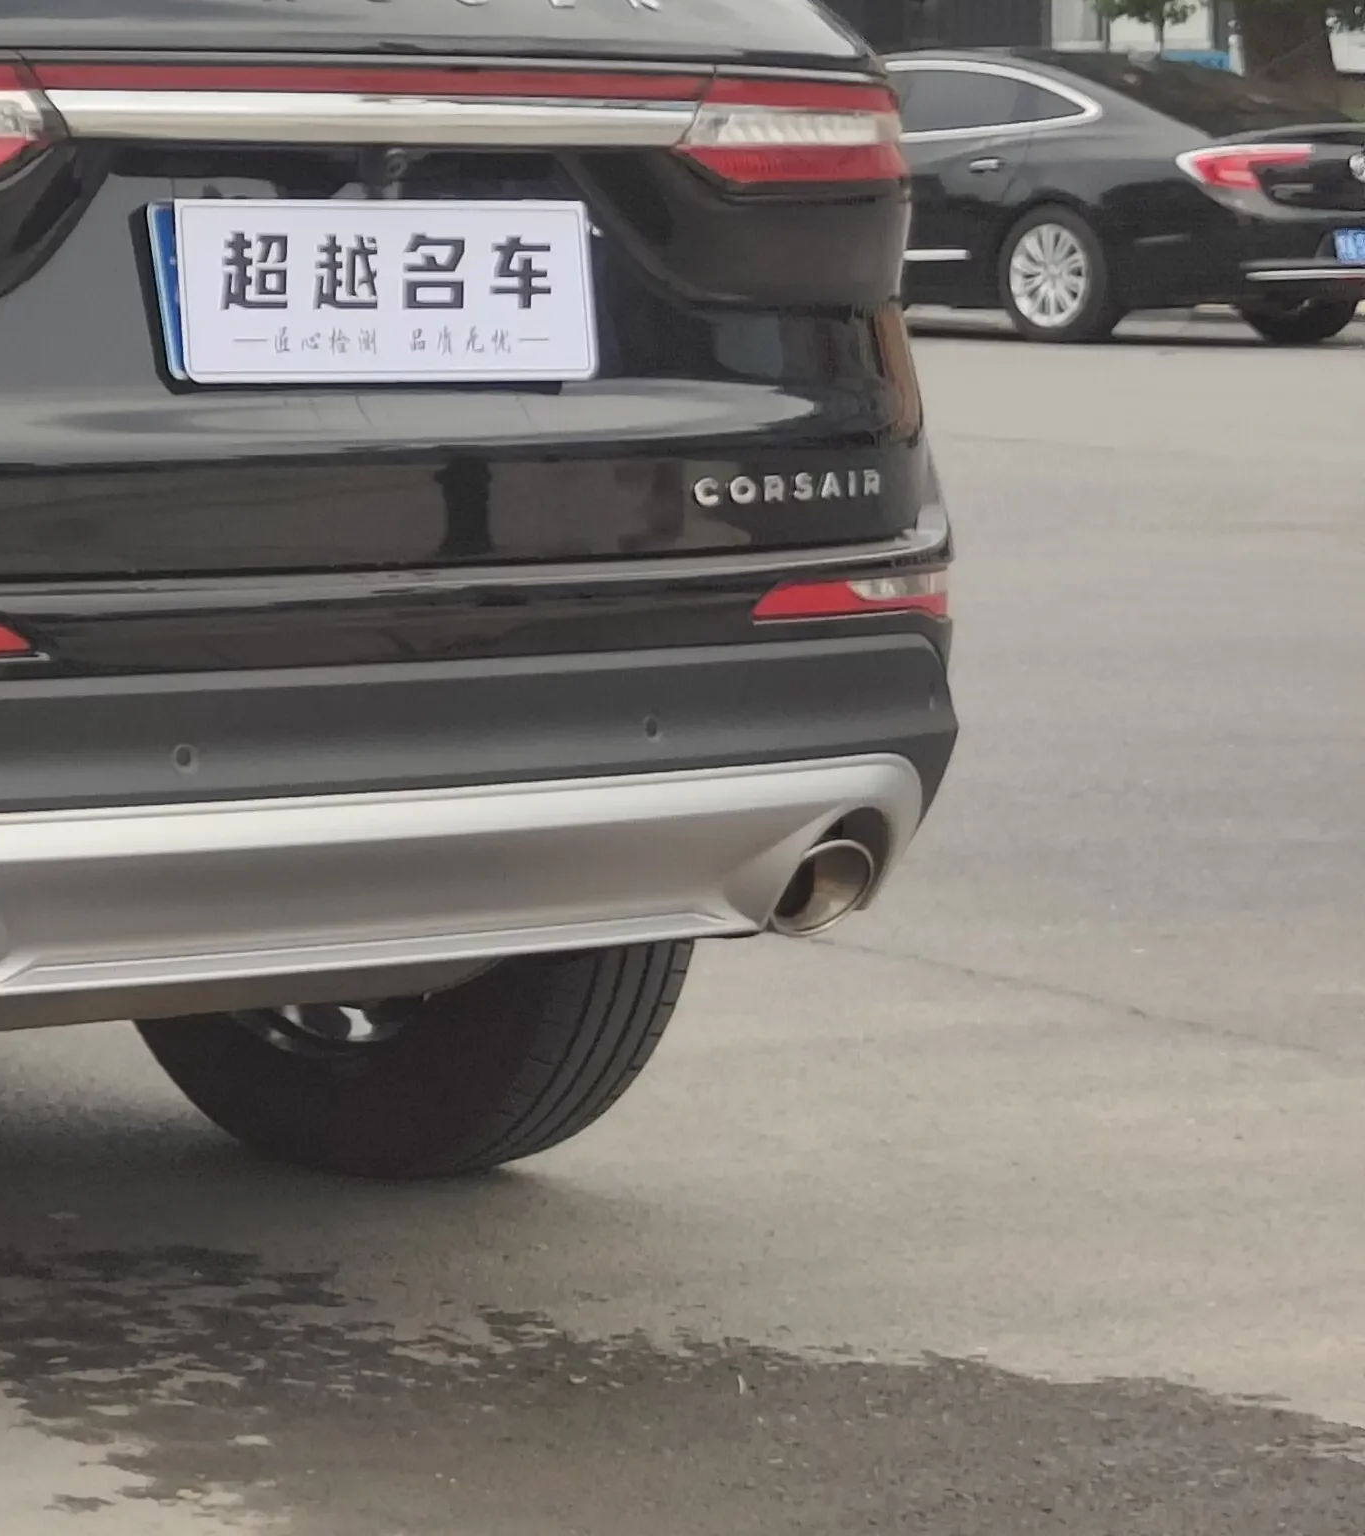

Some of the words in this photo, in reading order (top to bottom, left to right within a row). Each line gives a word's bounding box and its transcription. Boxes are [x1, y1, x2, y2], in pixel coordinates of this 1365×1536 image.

[219, 229, 552, 311] 超越名车
[693, 468, 881, 507] CORSAIR
